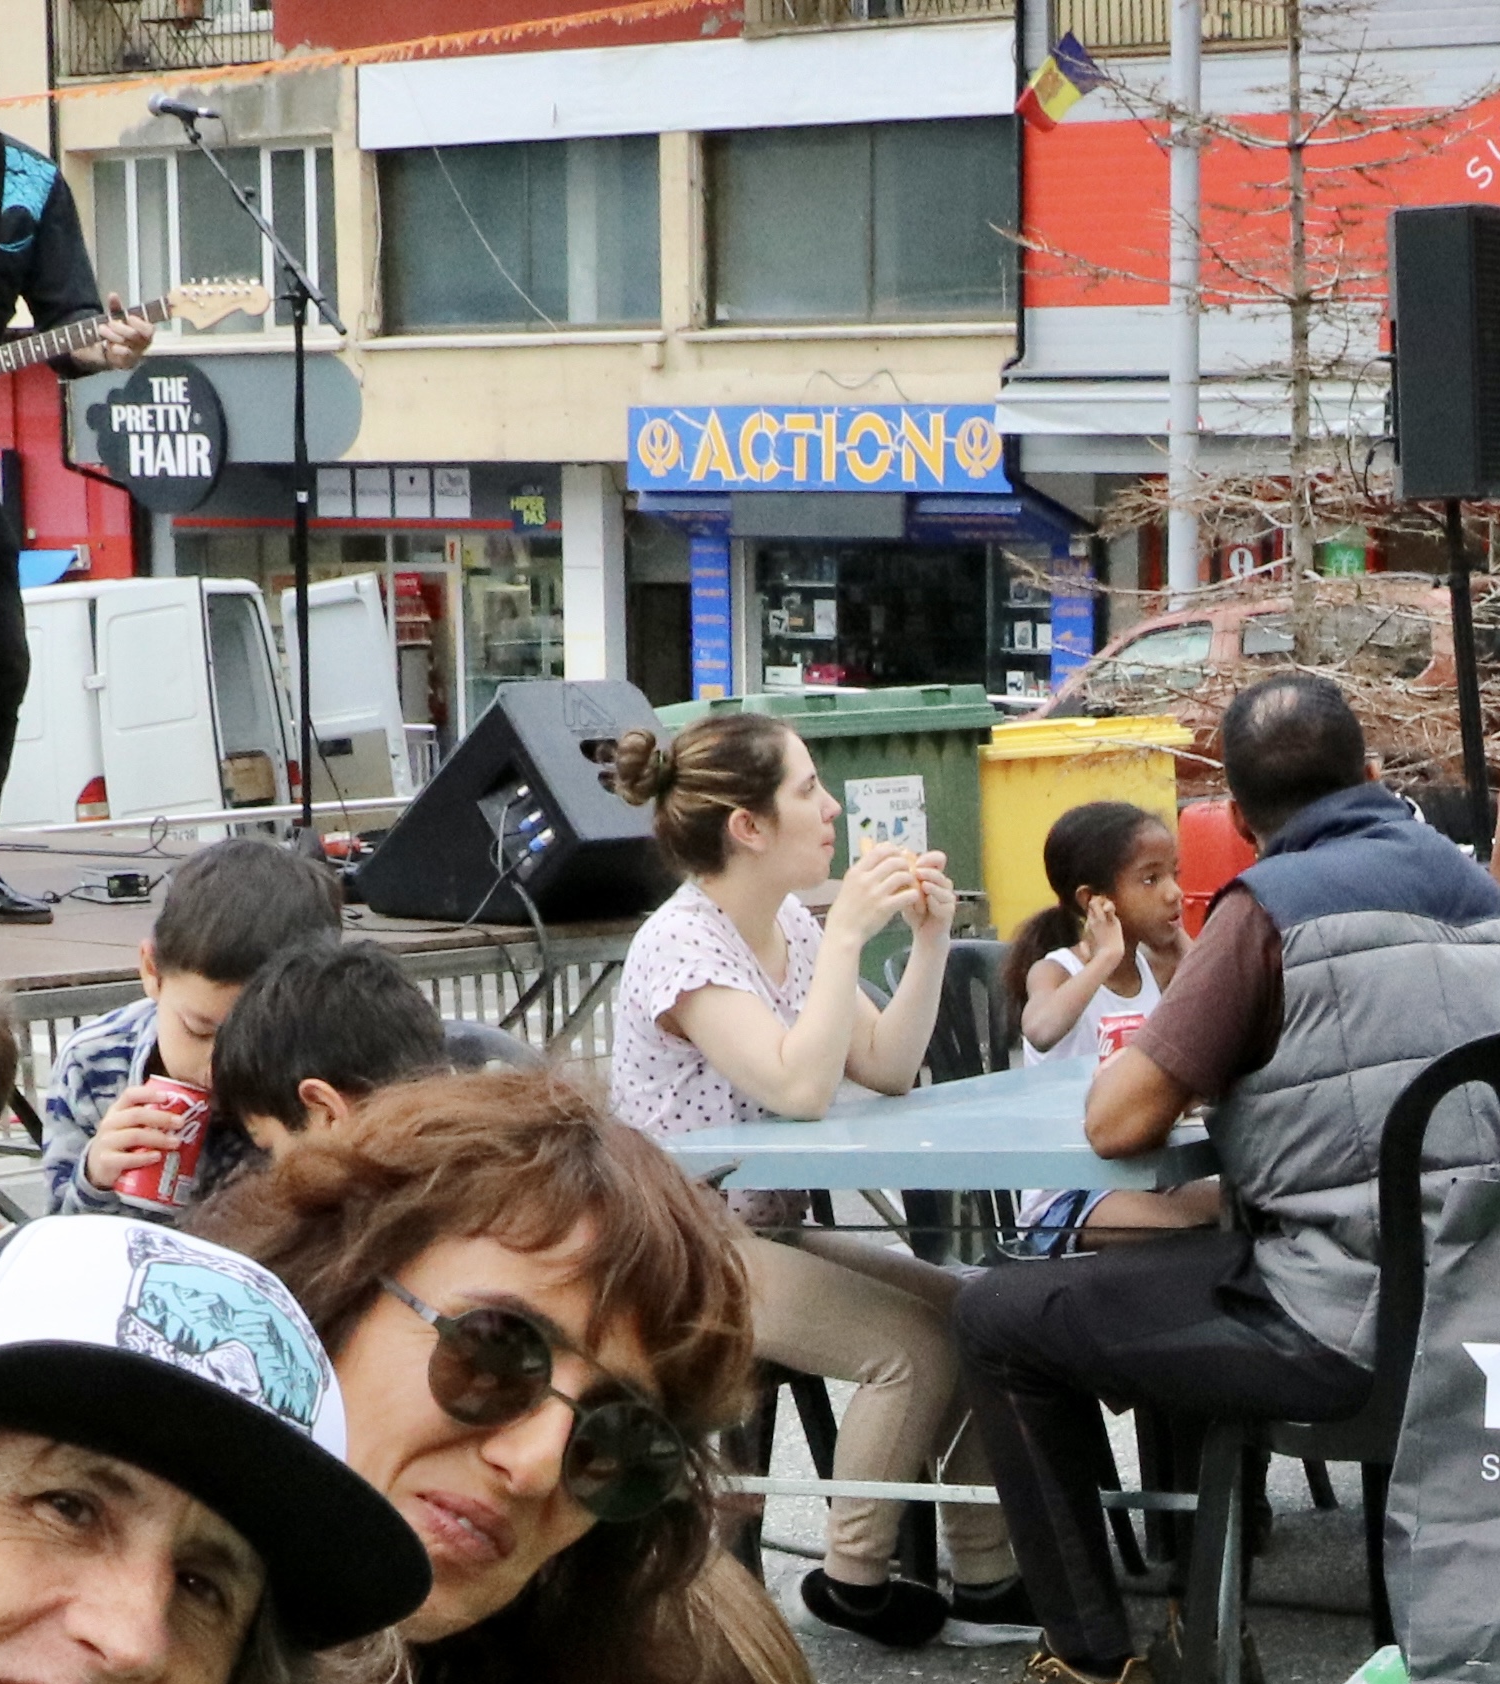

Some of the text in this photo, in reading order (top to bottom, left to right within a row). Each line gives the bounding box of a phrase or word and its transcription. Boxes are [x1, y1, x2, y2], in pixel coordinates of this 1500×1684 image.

[148, 376, 190, 403] THE
[110, 404, 192, 432] PRETTY
[128, 432, 213, 477] HAIR
[689, 408, 946, 486] ACTION
